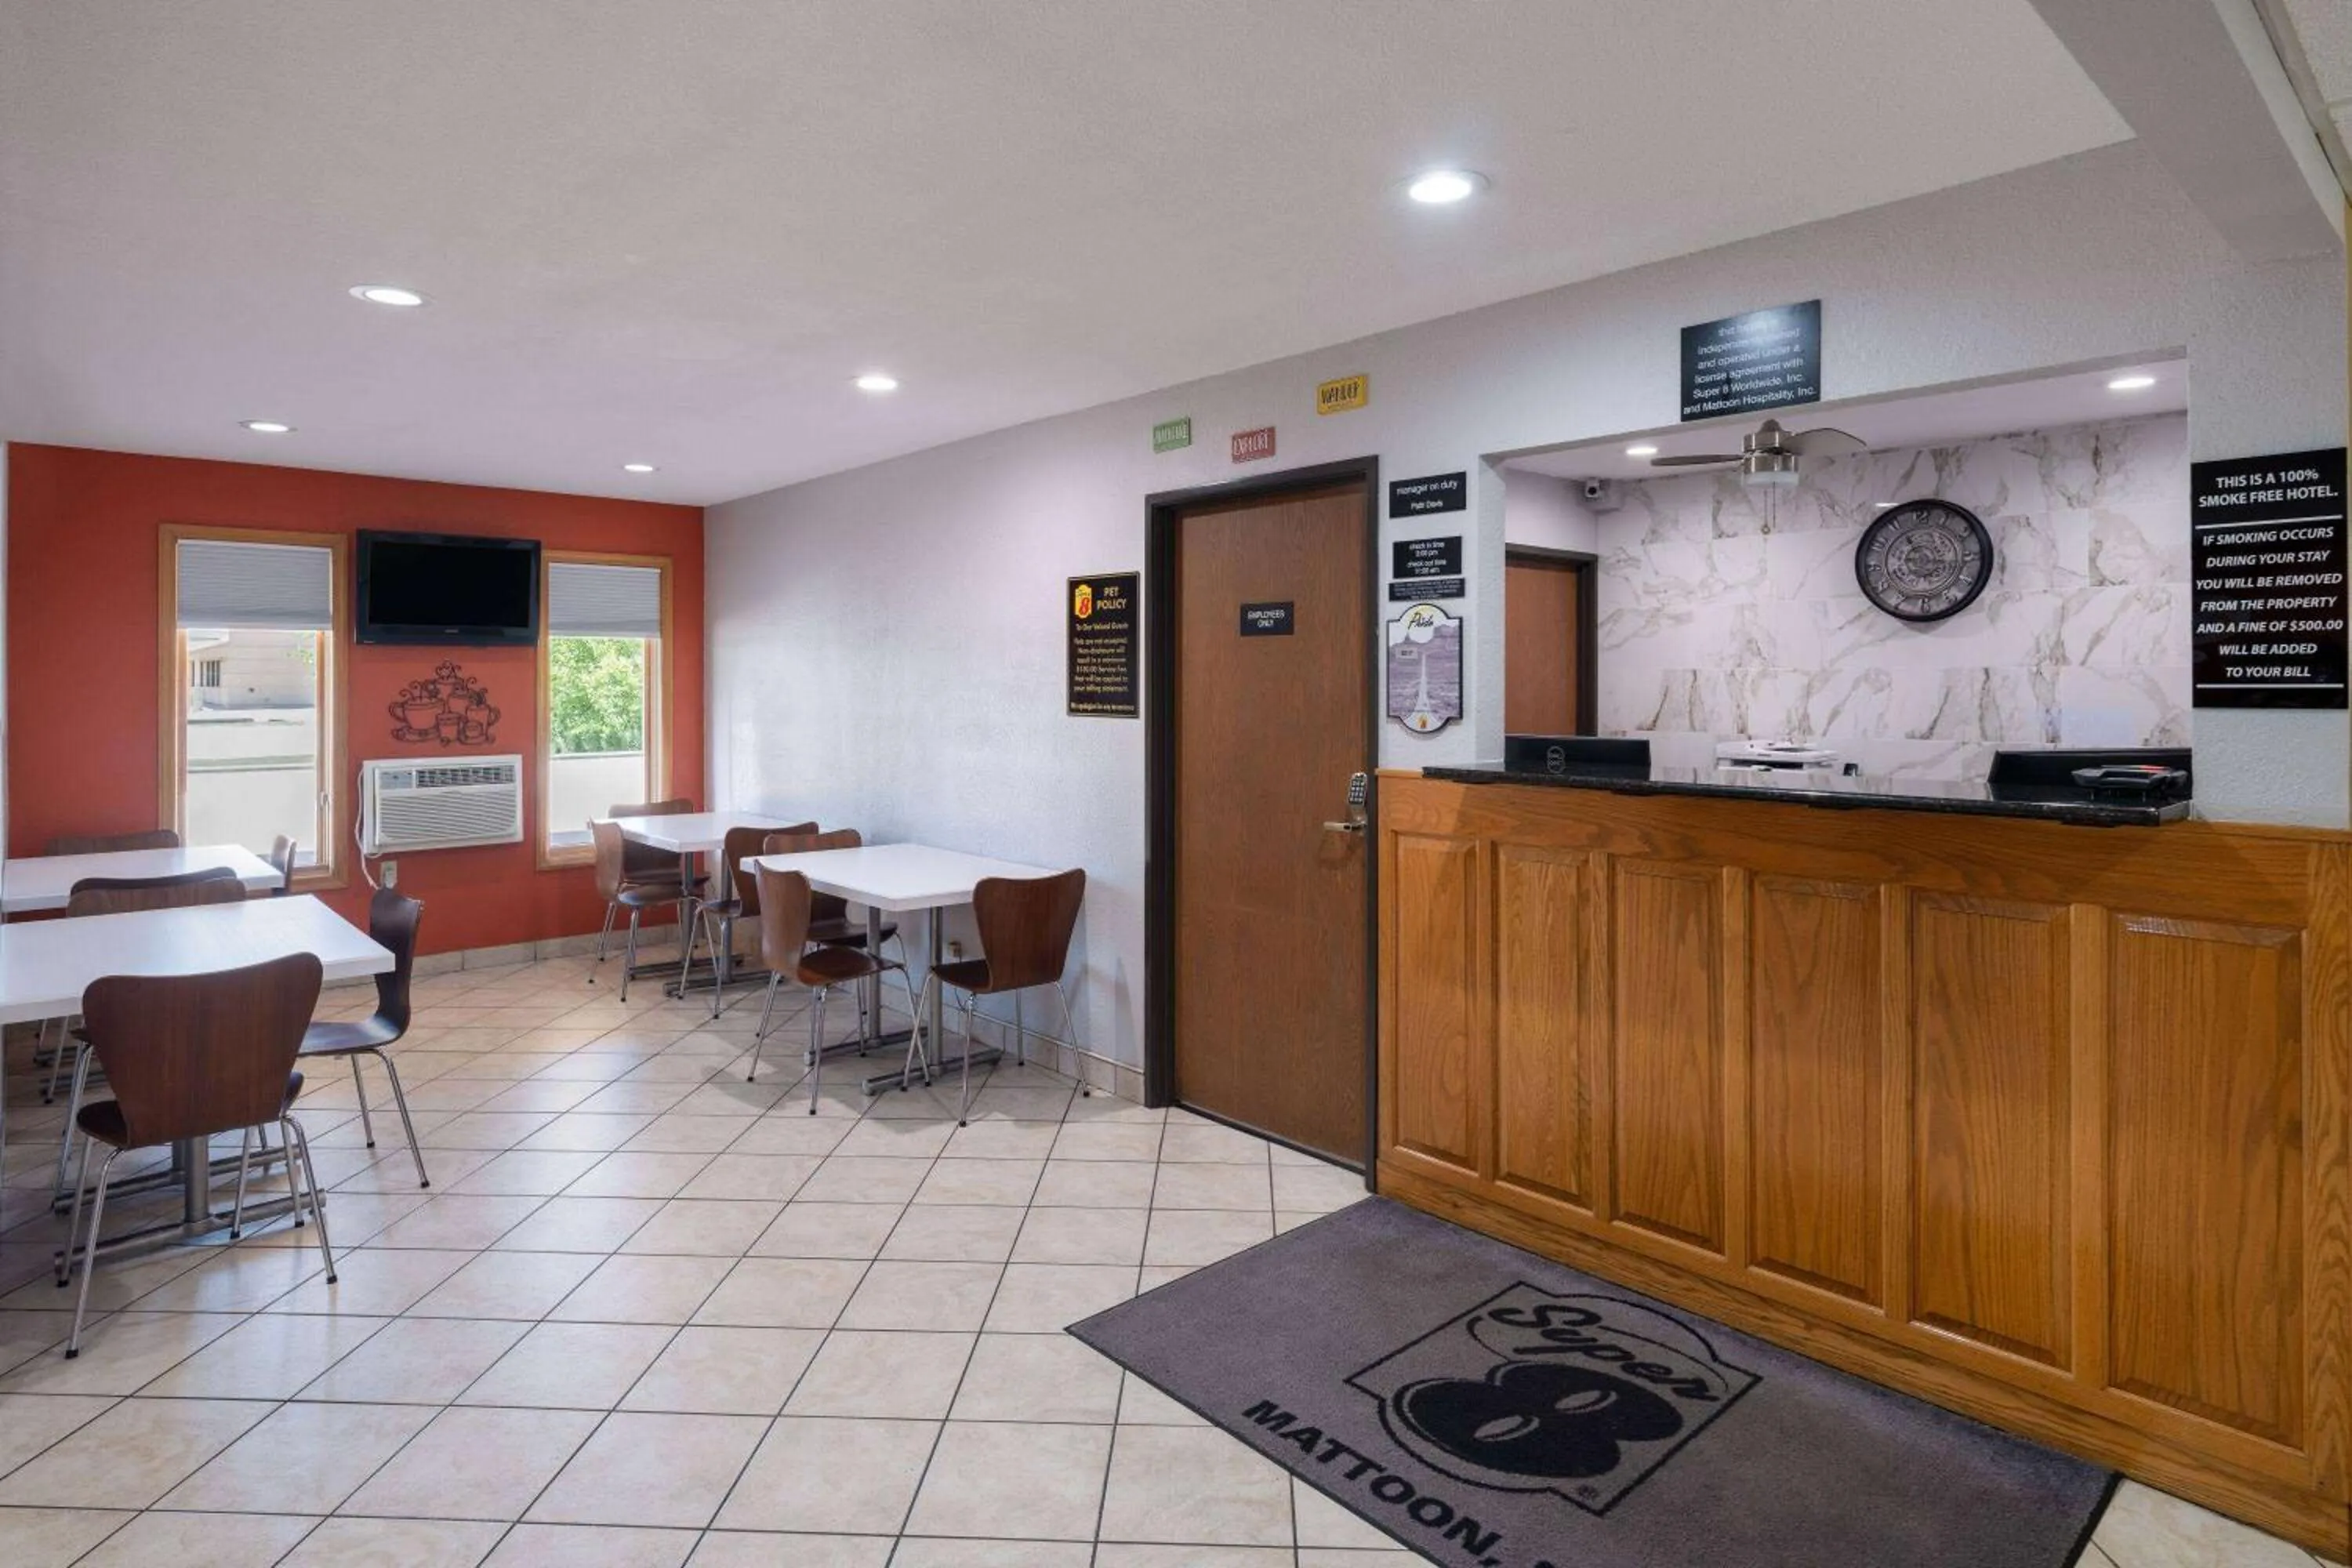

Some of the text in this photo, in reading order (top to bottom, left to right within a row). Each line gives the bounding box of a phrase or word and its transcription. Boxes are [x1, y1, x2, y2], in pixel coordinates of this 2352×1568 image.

[1694, 356, 1804, 386] license agreement with
[1697, 358, 1716, 369] and
[1693, 388, 1719, 401] Super
[1722, 383, 1729, 394] 8
[1683, 403, 1700, 415] and
[1702, 398, 1741, 412] Mattoon
[1743, 389, 1795, 405] Hospitality,
[1397, 480, 1457, 495] manager on duty
[2216, 469, 2319, 488] THIS IS A 100%
[2198, 485, 2338, 507] SMOKE FREE HOTEL.
[2203, 527, 2334, 546] IF SMOKING OCCURS
[2205, 550, 2331, 568] DURING YOUR STAY
[2196, 573, 2343, 590] YOU WILL BE REMOVED
[1103, 586, 1120, 597] PET
[1096, 598, 1127, 610] POLICY
[2201, 596, 2338, 612] FROM THE PROPERTY
[1247, 609, 1285, 628] EMPLOYEES ONLY
[2196, 619, 2343, 634] AND A FINE OF $500.00
[2219, 643, 2318, 655] WILL BE ADDED
[2225, 666, 2312, 678] TO YOUR BILL
[1488, 1304, 1721, 1402] Super
[1393, 1363, 1683, 1479] 8
